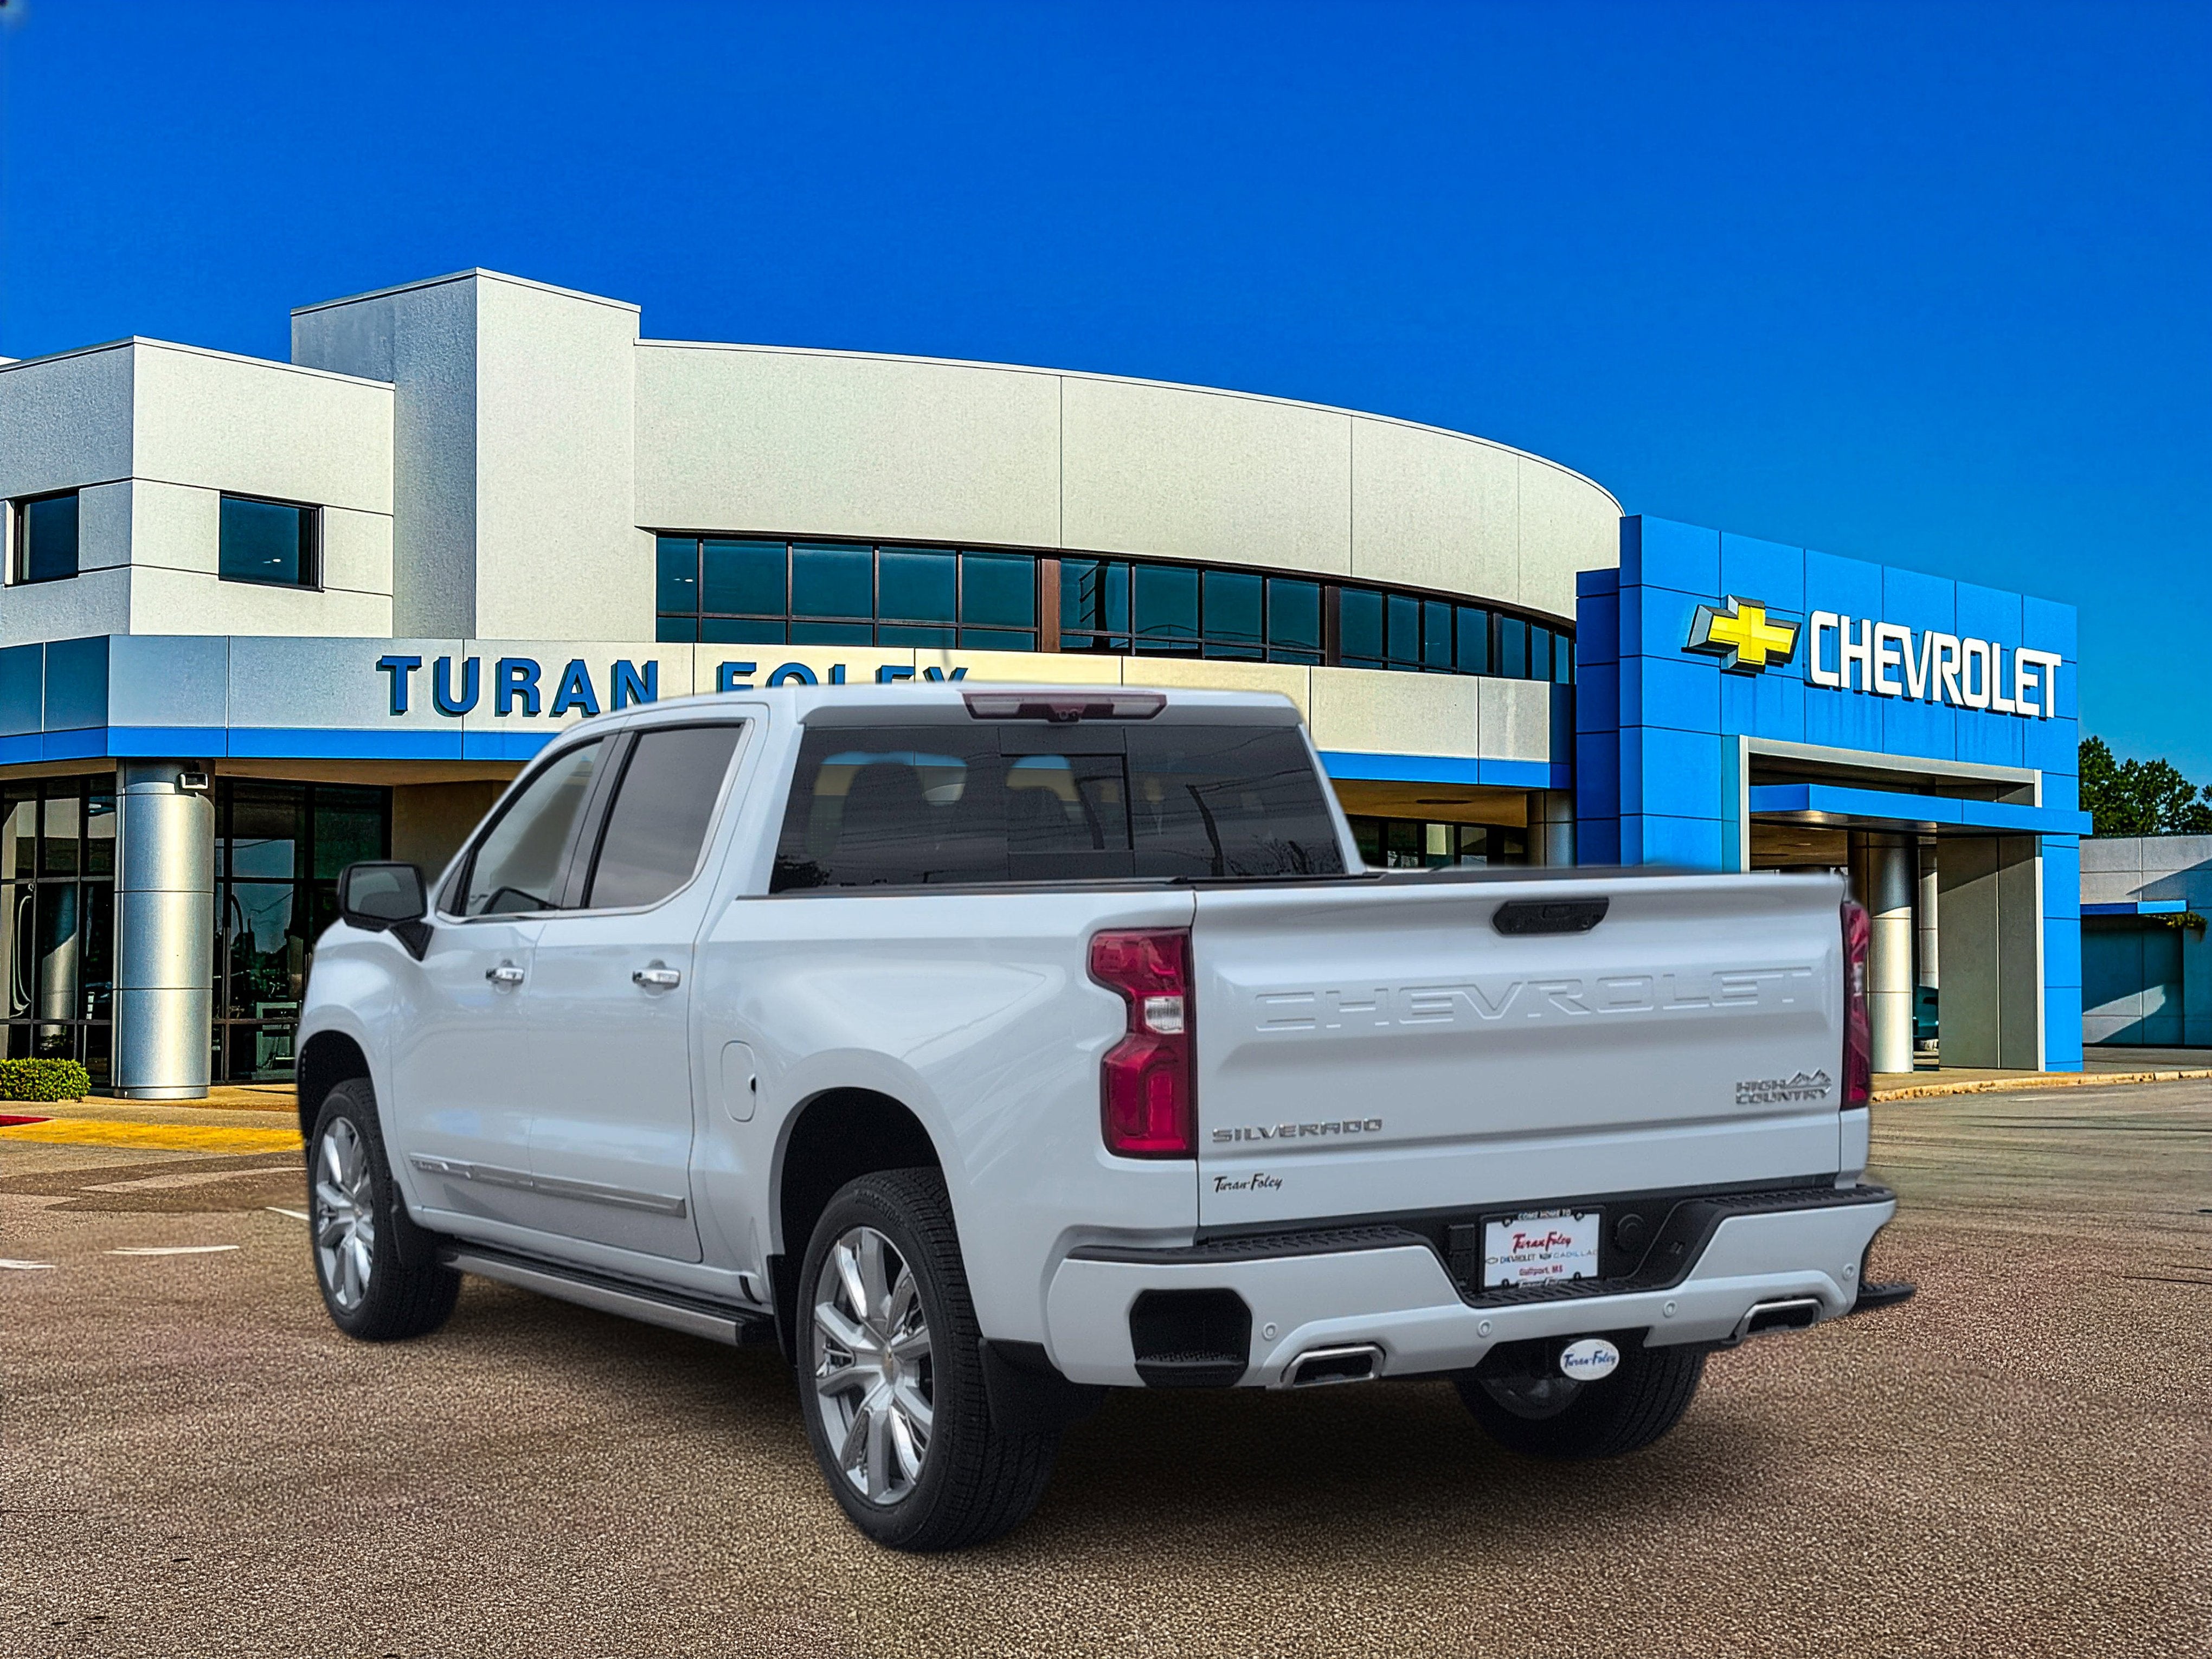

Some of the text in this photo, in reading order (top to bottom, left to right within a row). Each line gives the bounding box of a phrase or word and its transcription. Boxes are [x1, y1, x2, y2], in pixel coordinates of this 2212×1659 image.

[1809, 609, 2062, 718] CHEVROLET
[376, 655, 658, 717] TURAN
[1255, 966, 1812, 1031] CHEVROLET
[1736, 1079, 1786, 1092] HIGH
[1736, 1088, 1831, 1104] COUNTRY
[1212, 1119, 1382, 1143] SILVERADO
